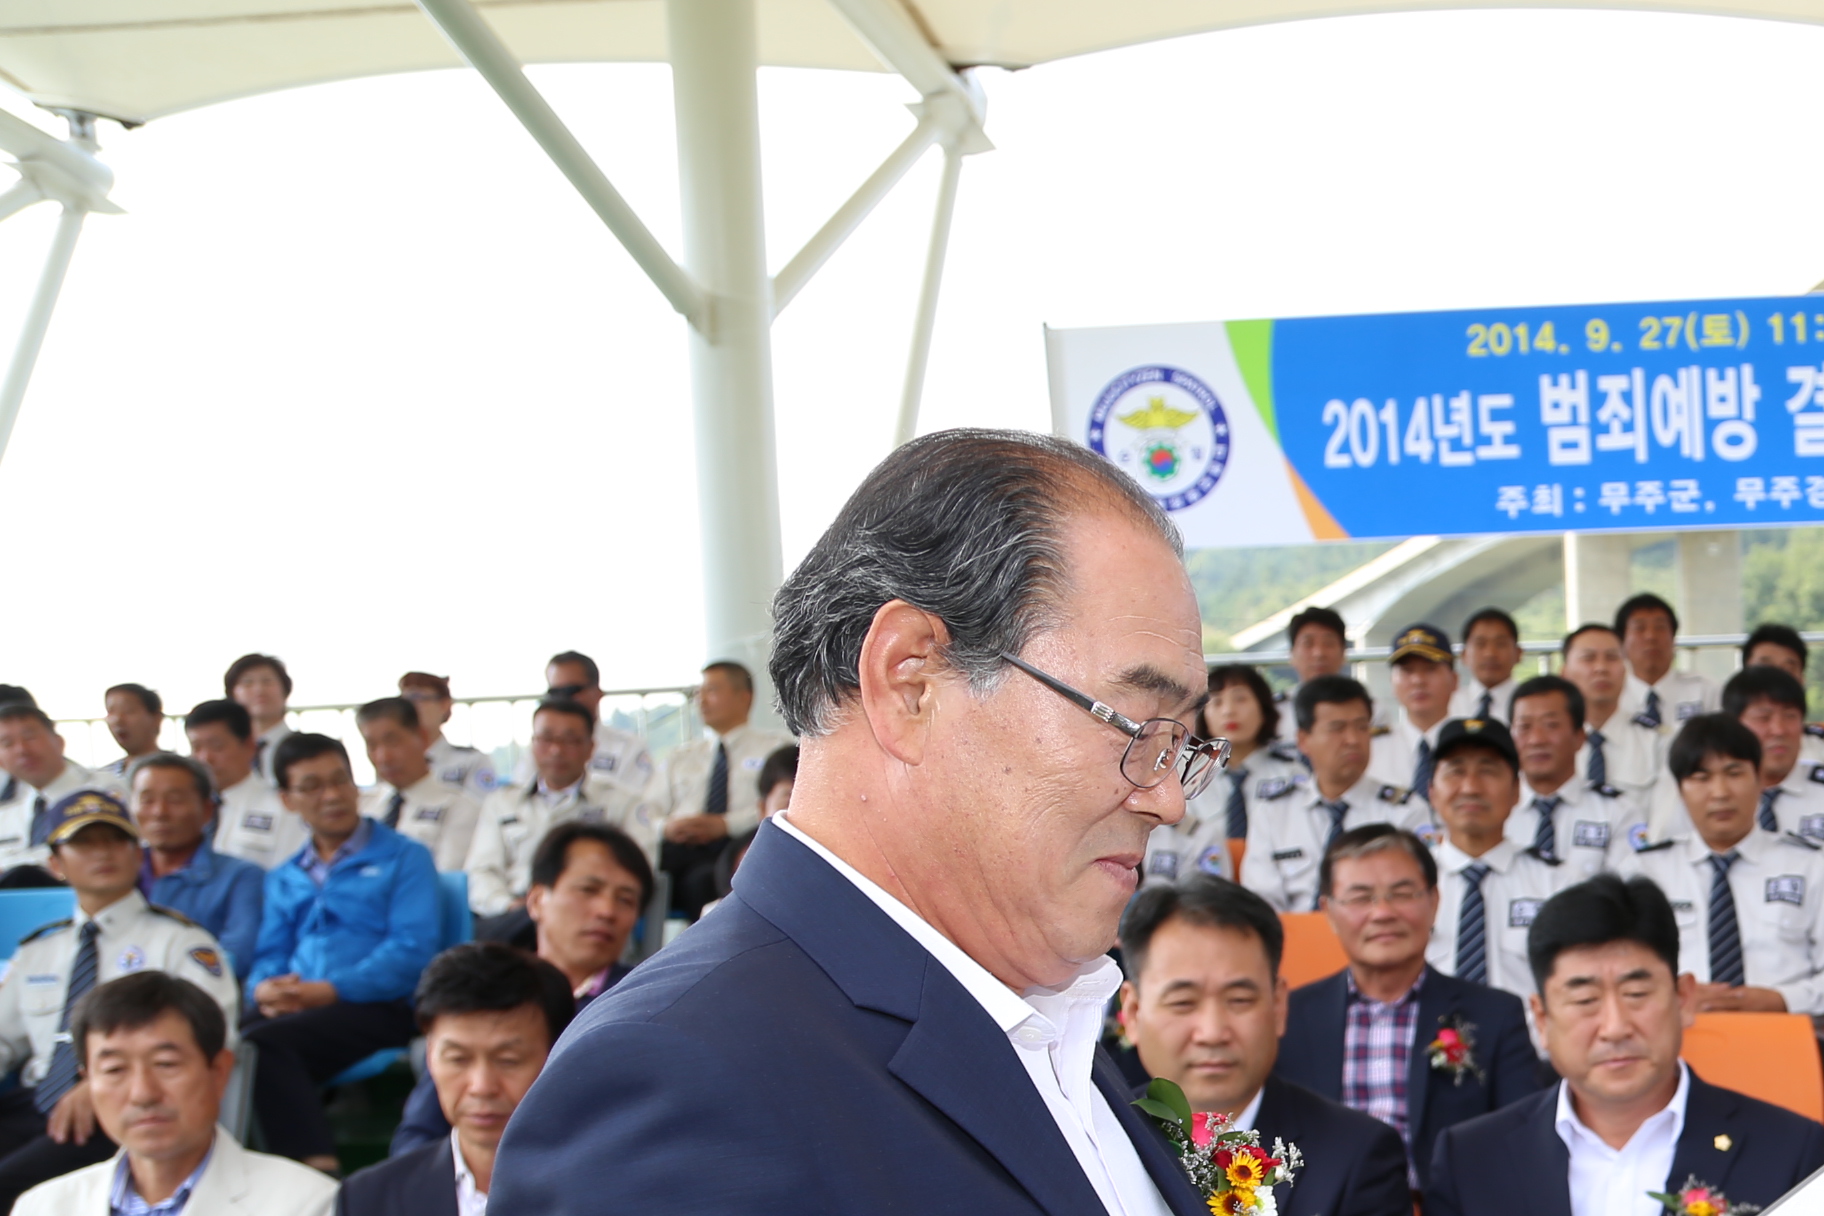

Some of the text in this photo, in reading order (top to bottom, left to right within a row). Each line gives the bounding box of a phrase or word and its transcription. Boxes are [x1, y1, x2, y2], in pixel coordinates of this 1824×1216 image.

[1466, 321, 1570, 358] 2014.
[1585, 318, 1623, 353] 9.
[1638, 309, 1750, 352] 27(토)
[1321, 389, 1522, 468] 2014년도
[1538, 362, 1762, 466] 범죄예방
[1495, 483, 1563, 519] 주최
